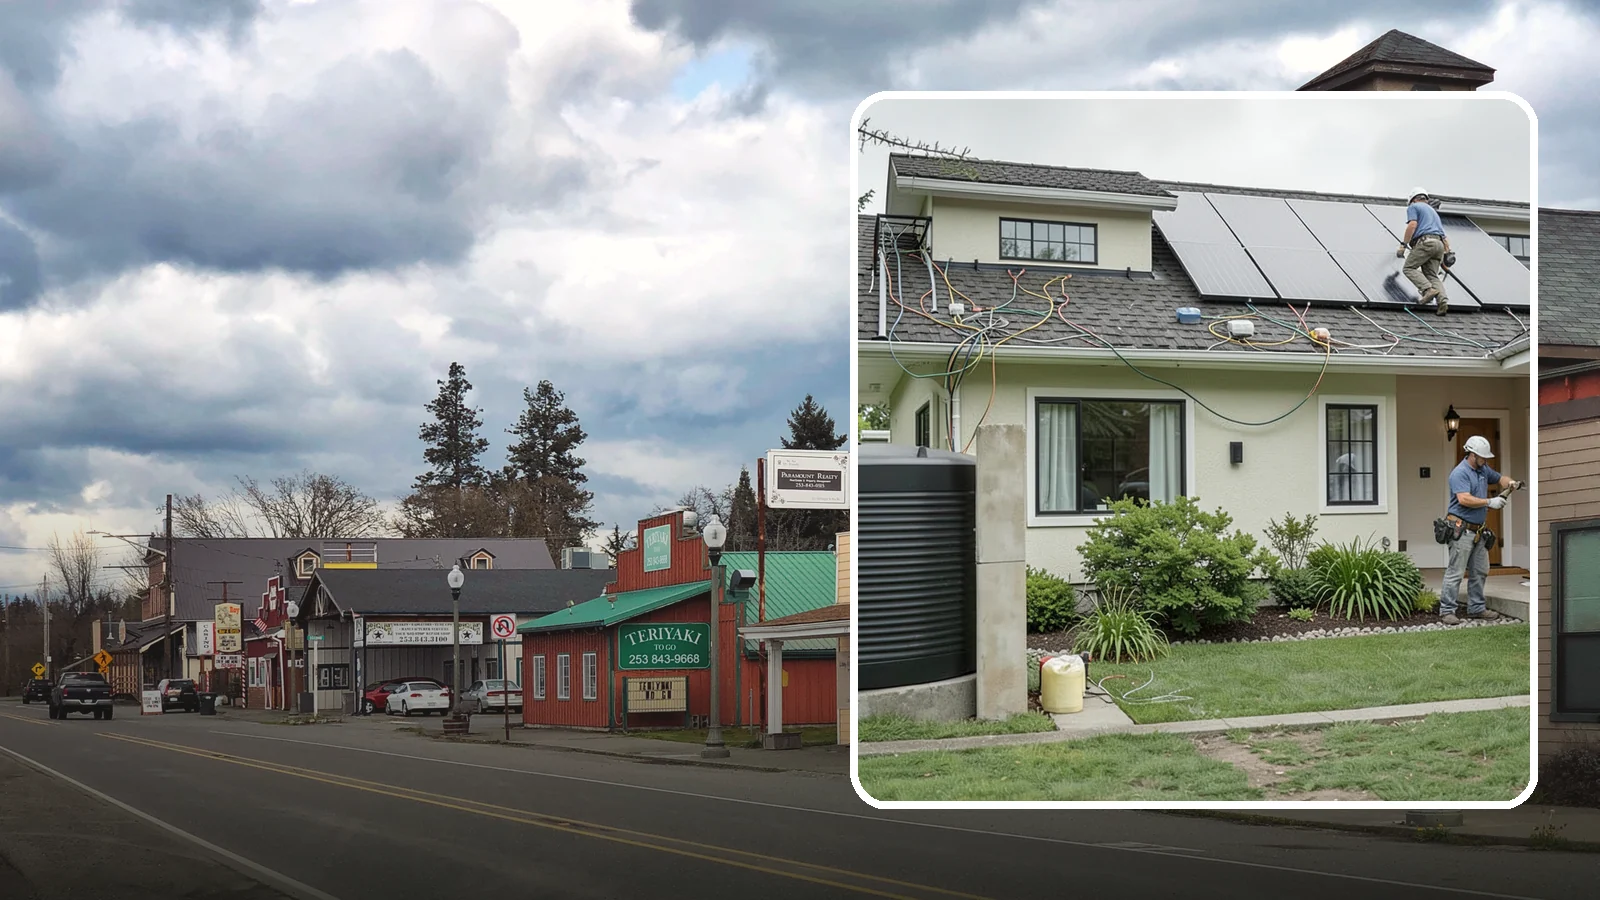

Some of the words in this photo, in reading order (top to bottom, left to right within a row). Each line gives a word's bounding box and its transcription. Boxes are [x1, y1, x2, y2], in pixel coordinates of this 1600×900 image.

[781, 471, 814, 479] PARAMOUNT
[624, 627, 702, 646] TERIYAKI
[629, 654, 648, 664] 253
[651, 653, 700, 664] 843-9668
